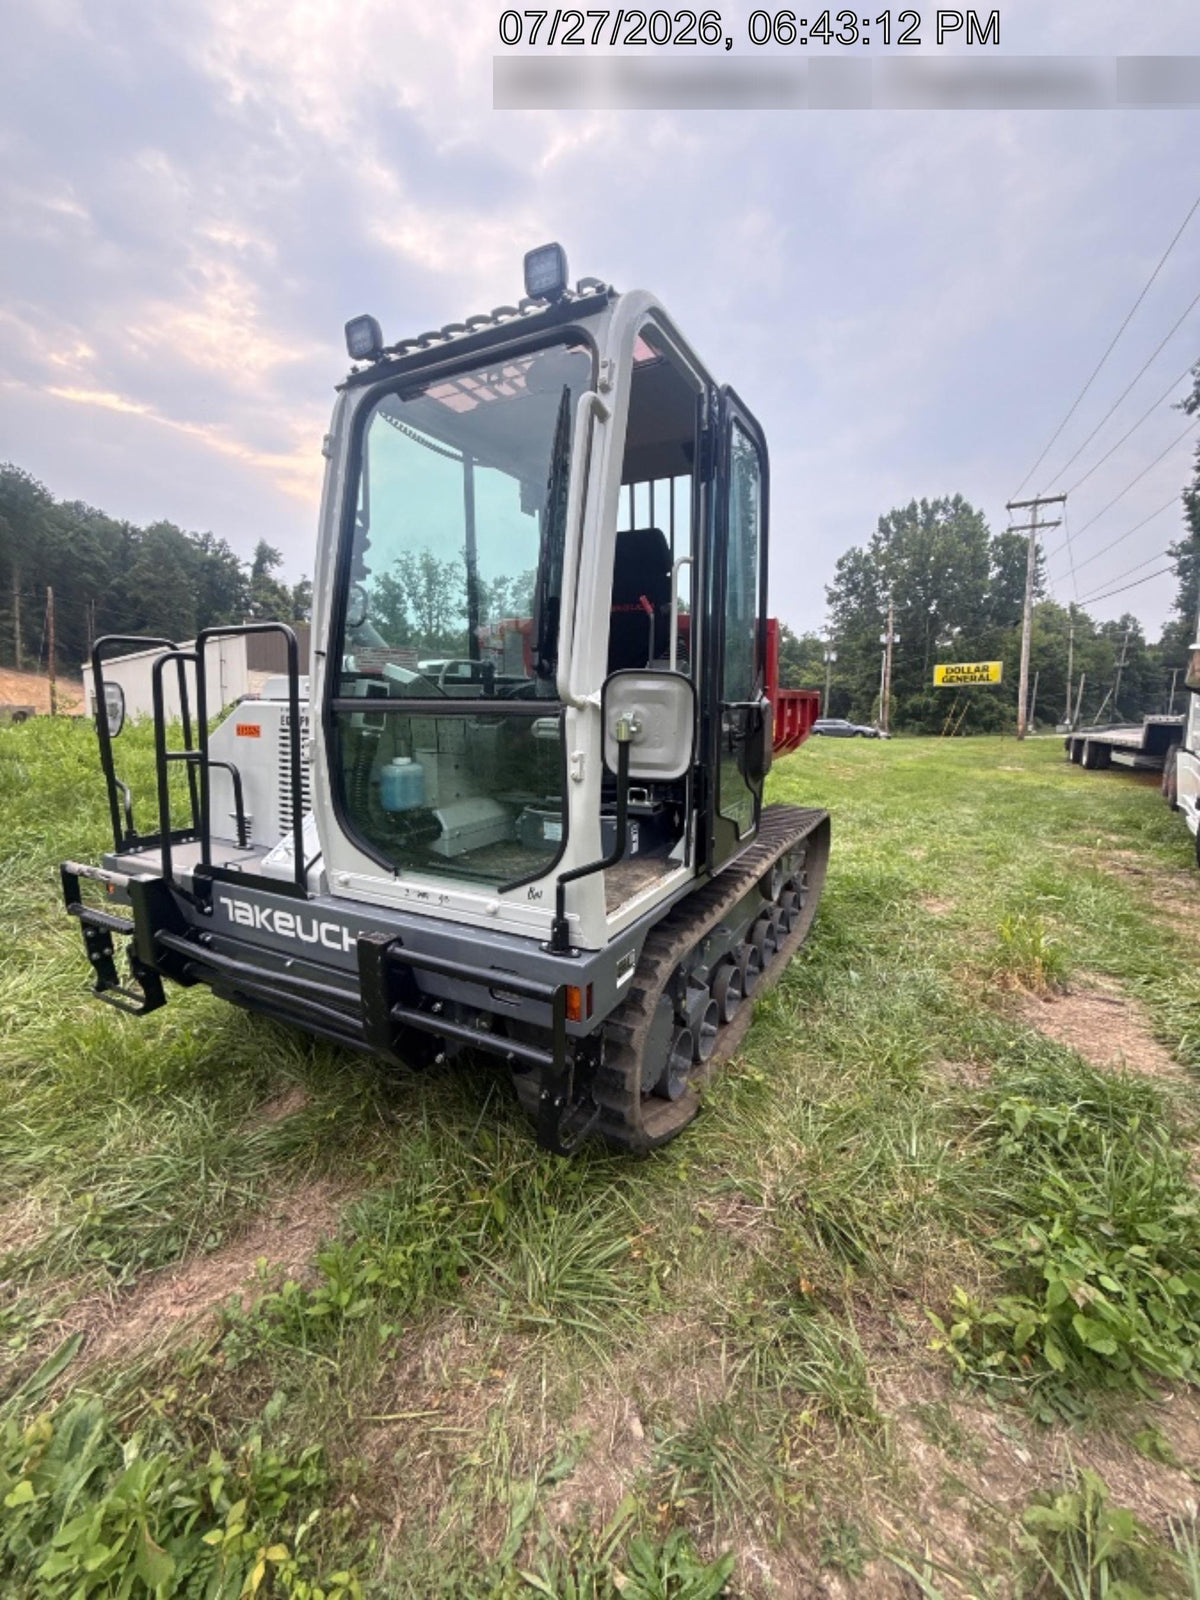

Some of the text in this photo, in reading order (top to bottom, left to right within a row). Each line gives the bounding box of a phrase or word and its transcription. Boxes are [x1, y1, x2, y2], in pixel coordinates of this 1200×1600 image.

[945, 664, 990, 674] DOLLAR
[942, 674, 992, 683] GENERAL
[219, 896, 358, 952] TAKEUCH
